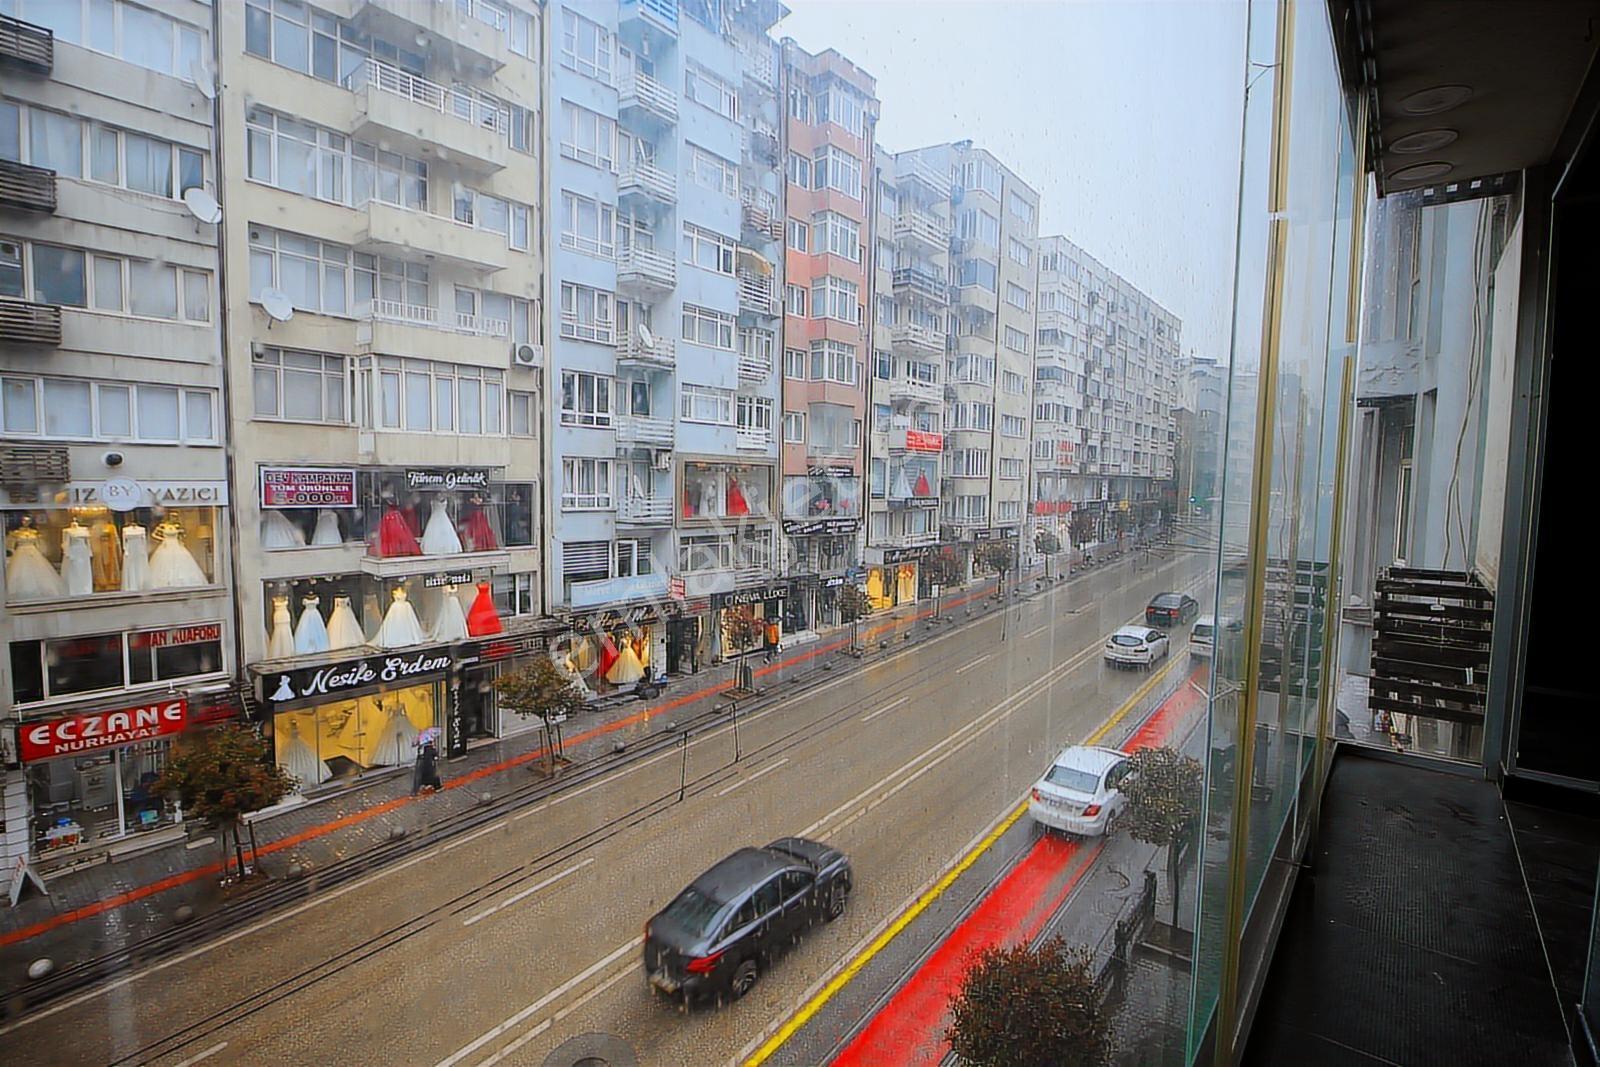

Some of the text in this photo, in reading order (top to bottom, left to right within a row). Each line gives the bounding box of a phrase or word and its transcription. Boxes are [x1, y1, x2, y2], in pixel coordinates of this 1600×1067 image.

[109, 485, 134, 498] BY
[265, 471, 290, 484] DEV
[381, 654, 452, 682] Erdem
[29, 702, 182, 745] ECZANE
[55, 725, 161, 754] NURHAYAT
